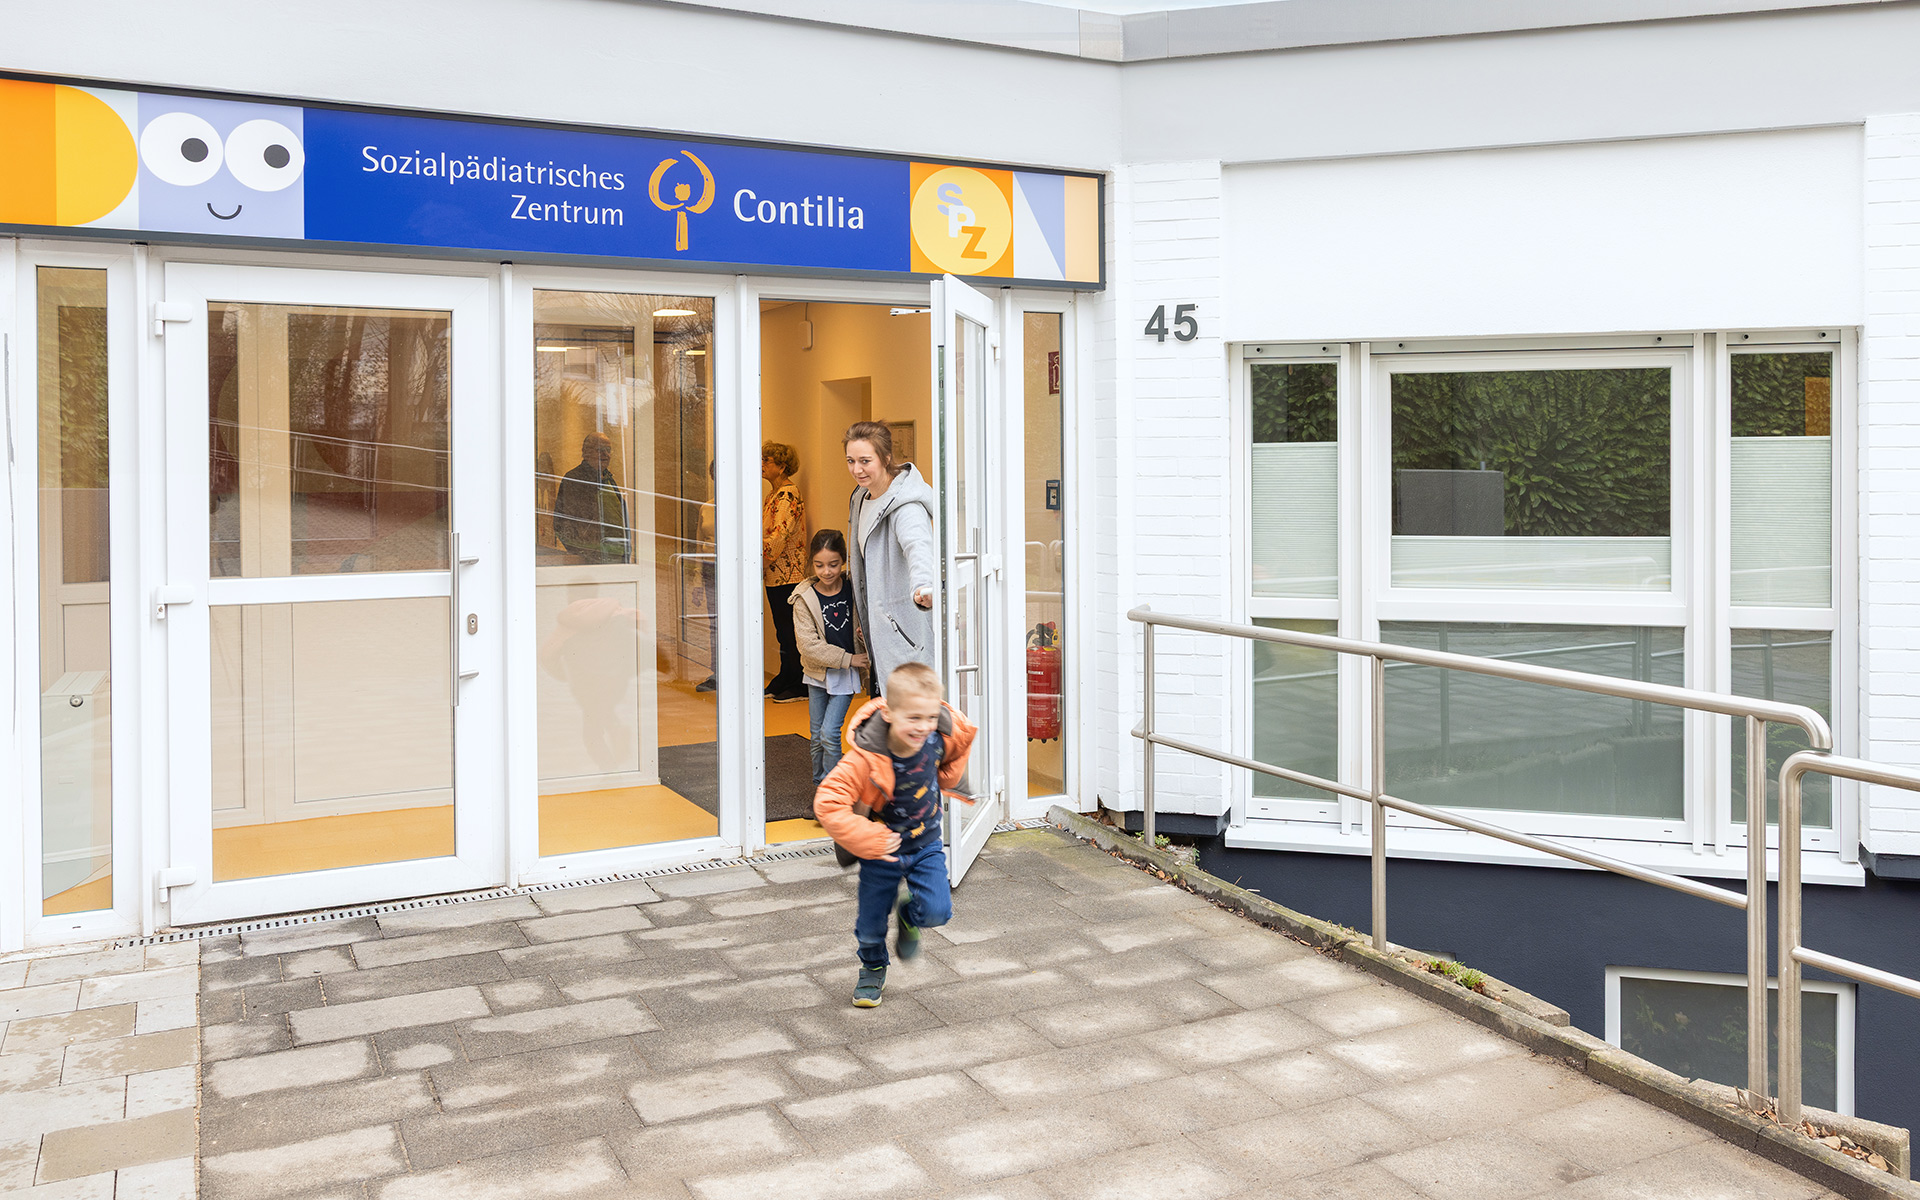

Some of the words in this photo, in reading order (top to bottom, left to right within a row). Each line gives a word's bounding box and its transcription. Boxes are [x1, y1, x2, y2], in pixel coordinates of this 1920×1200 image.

[361, 145, 626, 191] Sozialpädiatrisches
[510, 193, 624, 226] Zentrum
[733, 188, 865, 230] Contilia
[1144, 303, 1199, 343] 45
